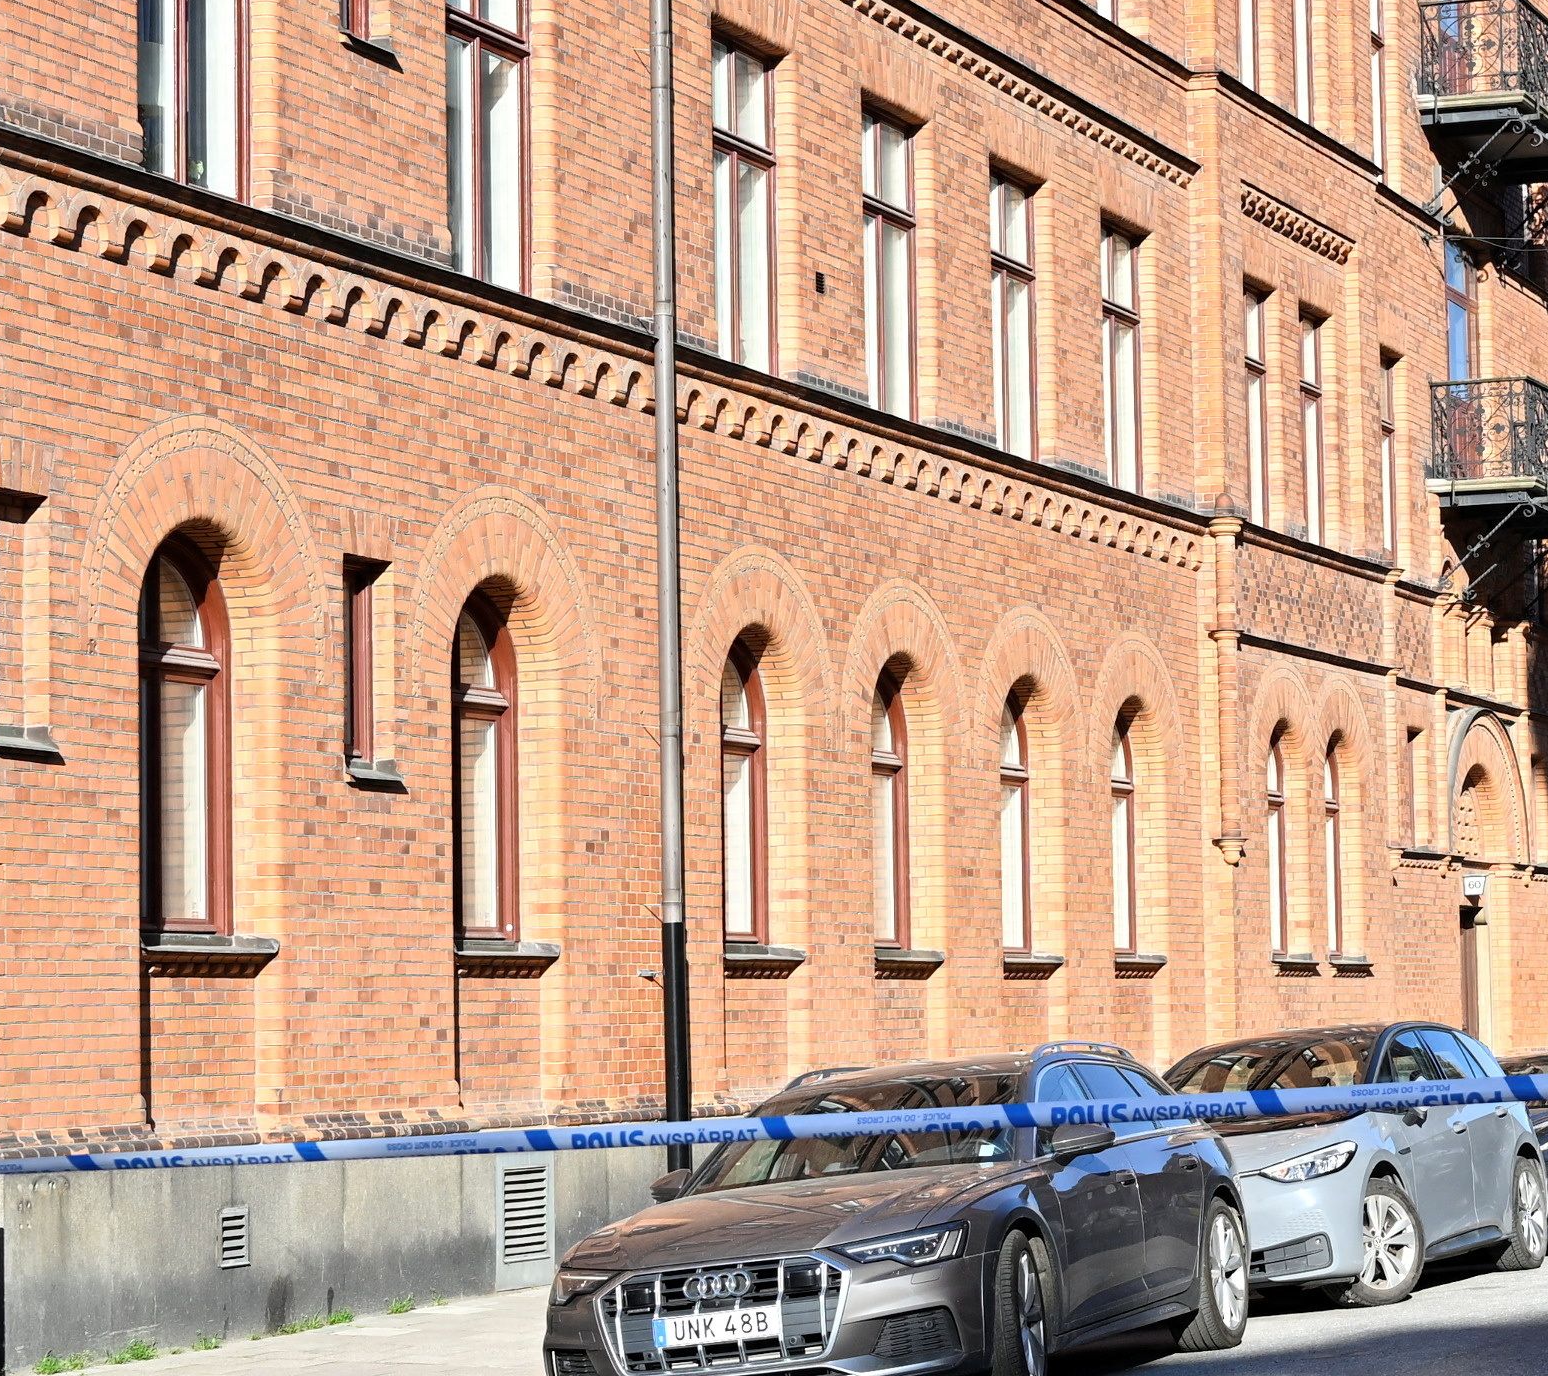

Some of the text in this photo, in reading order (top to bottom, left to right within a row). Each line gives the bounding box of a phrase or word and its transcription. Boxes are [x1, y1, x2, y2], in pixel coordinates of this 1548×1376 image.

[1468, 880, 1481, 889] 60
[1351, 1089, 1379, 1097] CROSS
[1381, 1087, 1398, 1095] NOT
[1401, 1086, 1414, 1094] DO
[1420, 1084, 1450, 1093] POLICE
[1051, 1101, 1247, 1125] POLIS AVSPÄRRAT
[673, 1311, 768, 1341] UNK 48B
